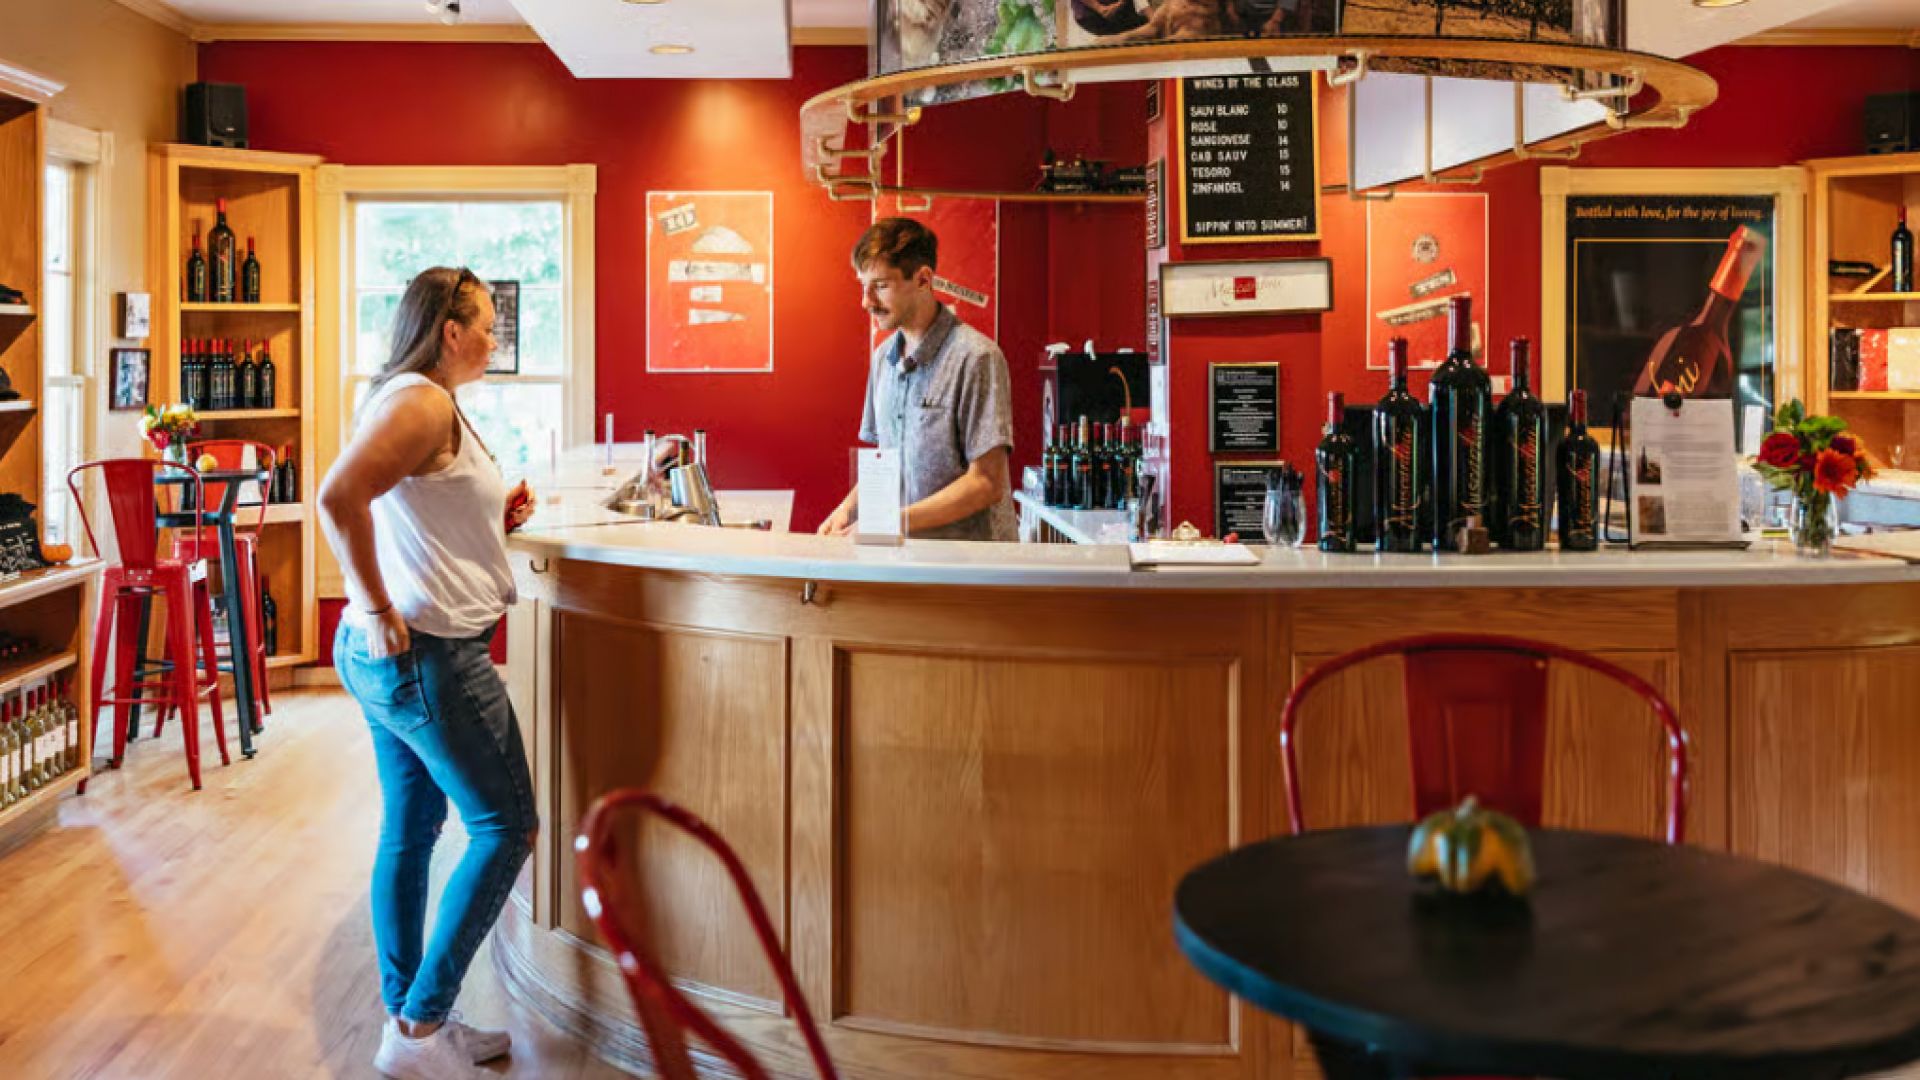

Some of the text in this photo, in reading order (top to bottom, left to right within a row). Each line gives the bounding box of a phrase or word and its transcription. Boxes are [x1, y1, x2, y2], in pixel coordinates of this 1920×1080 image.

[1193, 75, 1300, 89] WINES BY THE GLASS
[1190, 103, 1288, 117] SAUV BLANC 10
[1190, 119, 1288, 132] ROSE 10
[1190, 134, 1251, 147] SANGIOVESE
[1191, 149, 1289, 162] CAB SAUV 15
[1191, 166, 1231, 178] TESORO
[1192, 182, 1244, 194] ZINFANDEL
[1575, 205, 1612, 218] Bottled
[1614, 205, 1639, 218] with
[1682, 205, 1698, 218] the
[1234, 219, 1257, 232] INTO
[1260, 216, 1307, 231] SUMMER!
